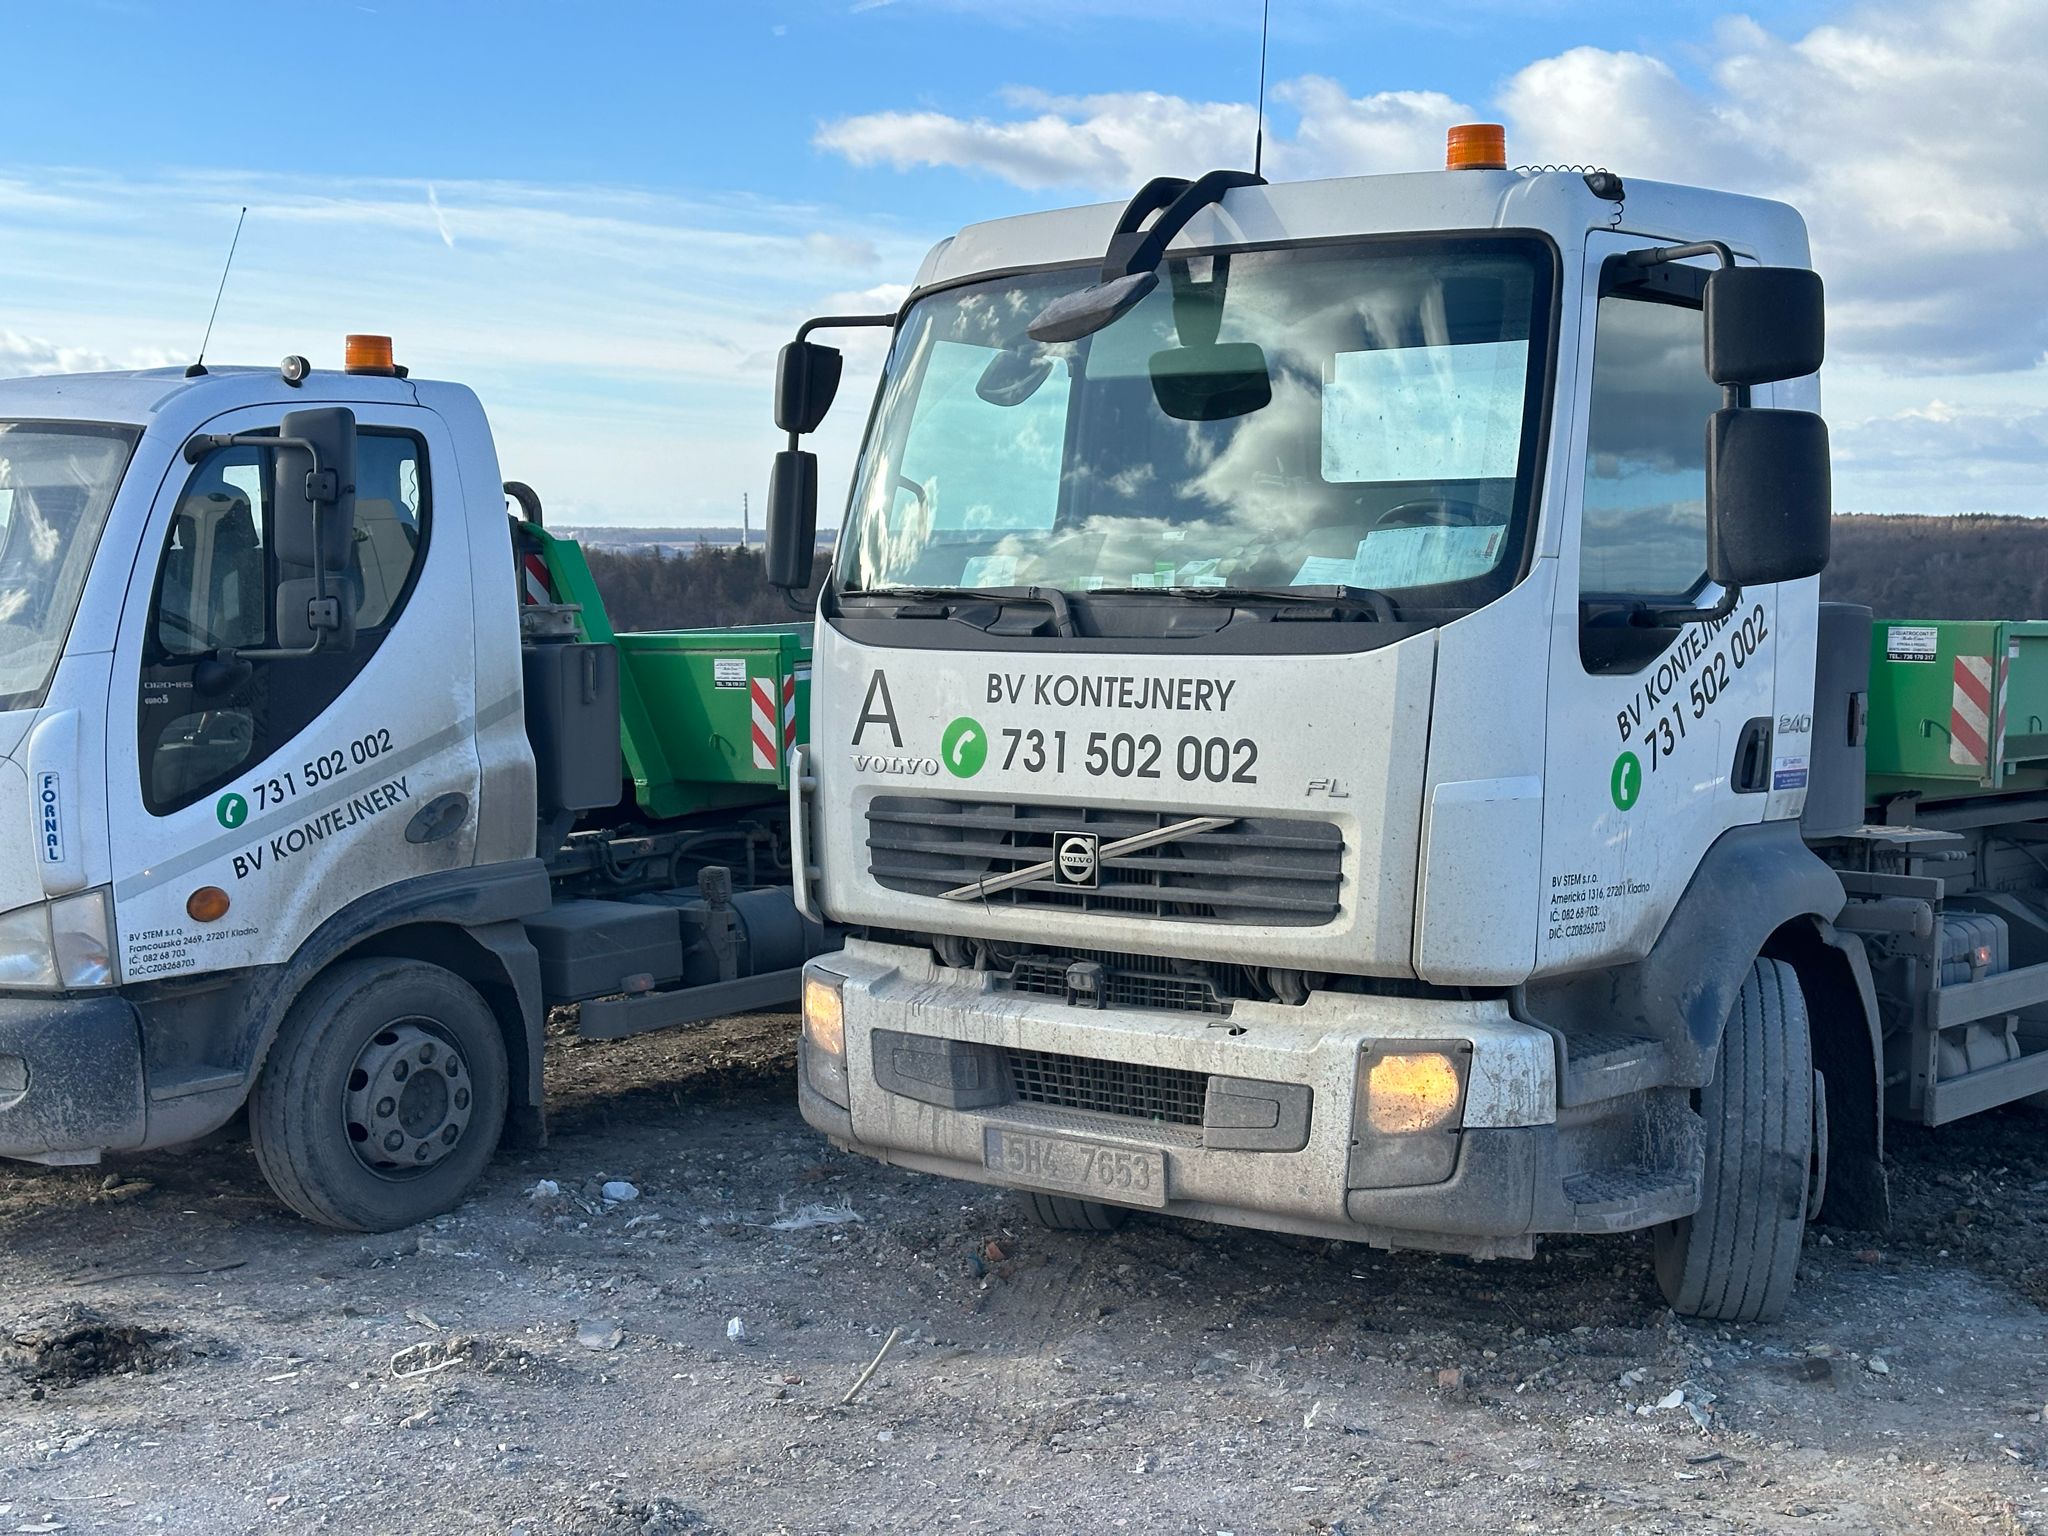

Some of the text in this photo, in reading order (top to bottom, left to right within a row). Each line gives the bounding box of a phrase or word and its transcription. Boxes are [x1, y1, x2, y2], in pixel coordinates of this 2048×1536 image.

[986, 673, 1236, 711] BV KONTEJNERY
[1644, 604, 1768, 773] 731 502 002
[851, 669, 904, 748] A
[1617, 693, 1641, 742] BV
[1778, 713, 1811, 734] 240
[850, 754, 940, 776] VOLVO
[1002, 728, 1258, 784] 731 502 002
[253, 728, 393, 811] 731 502 002
[1305, 778, 1349, 798] FL
[42, 775, 58, 860] FORNAL
[232, 776, 410, 880] BV KONTEJNERY
[1061, 856, 1093, 864] VOLVO
[1552, 873, 1598, 888] BV STEM s.r.o.
[1551, 891, 1586, 905] Americká
[1606, 884, 1626, 898] 27201
[1627, 883, 1650, 895] Kladno
[1562, 908, 1574, 920] 082
[129, 933, 140, 942] BV
[142, 929, 163, 940] STEM
[206, 931, 229, 941] 27201
[231, 928, 259, 938] Kladno
[143, 954, 158, 962] 082
[160, 951, 169, 960] 68
[171, 949, 186, 958] 703
[1080, 1146, 1150, 1190] 7653
